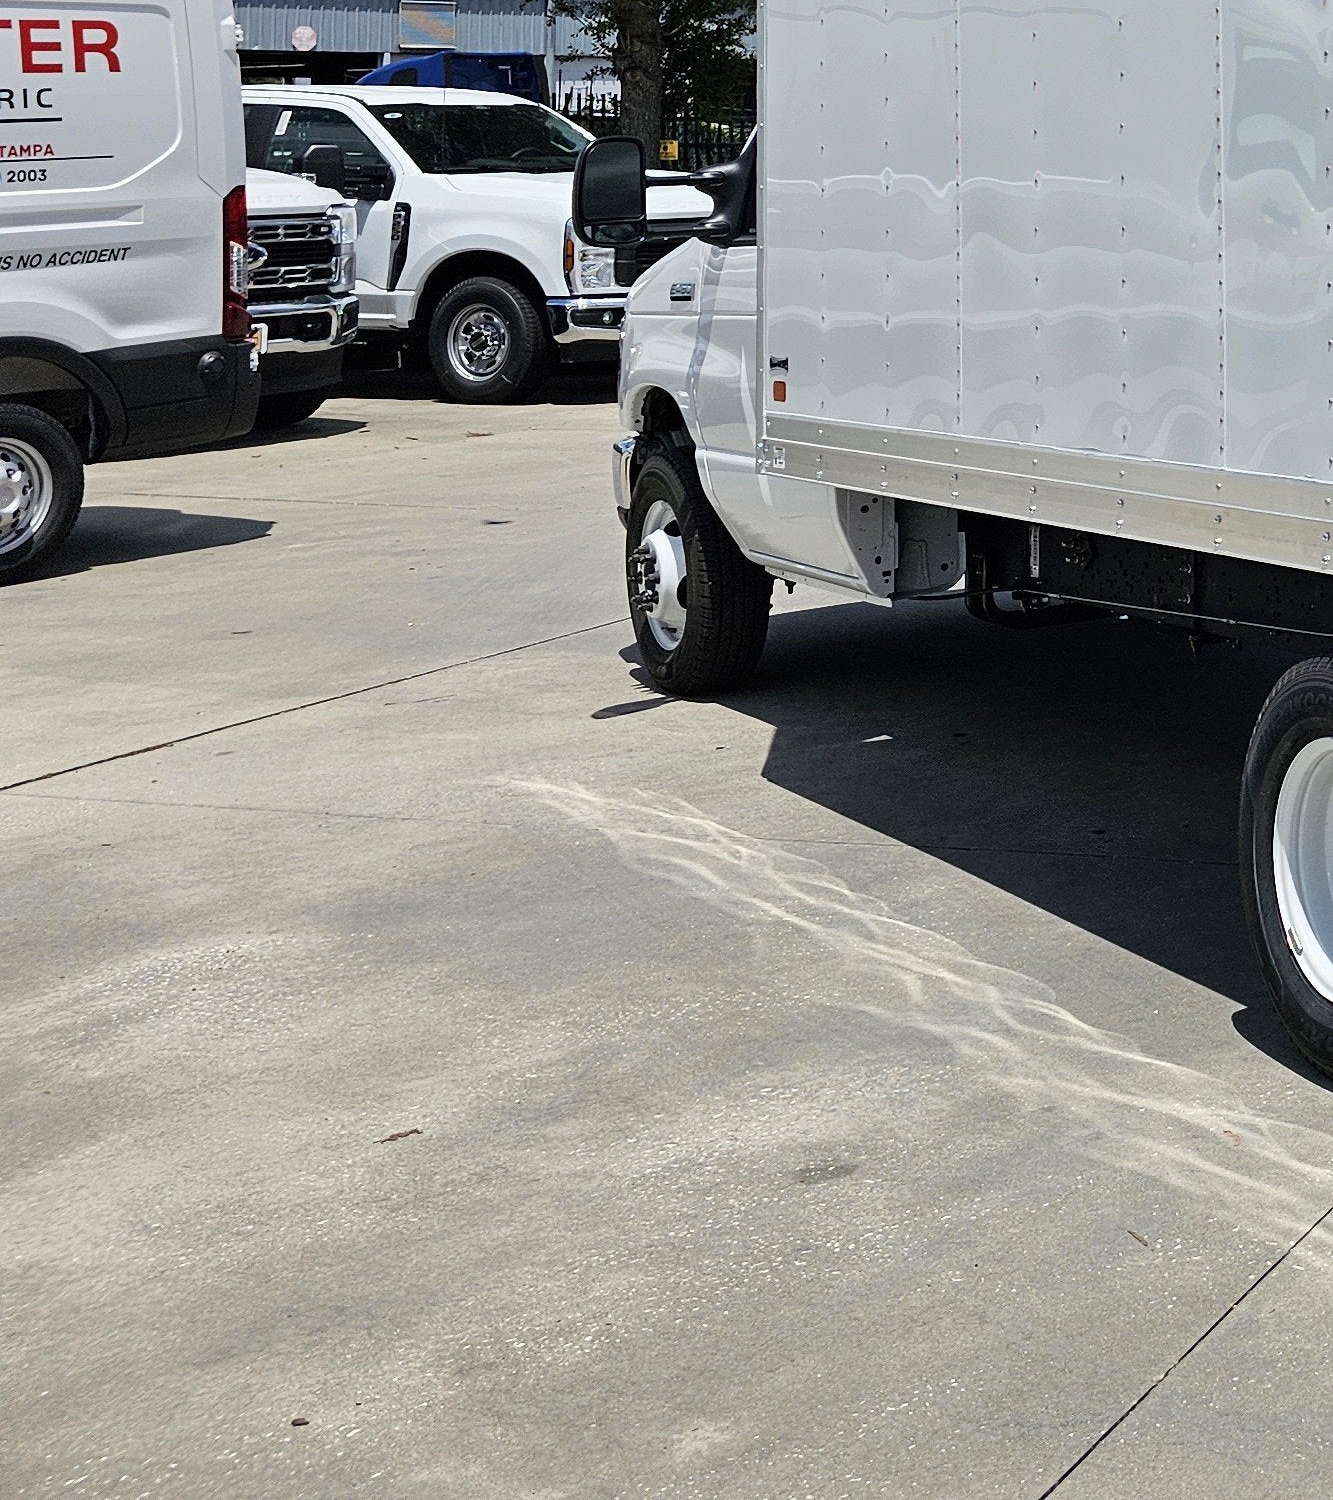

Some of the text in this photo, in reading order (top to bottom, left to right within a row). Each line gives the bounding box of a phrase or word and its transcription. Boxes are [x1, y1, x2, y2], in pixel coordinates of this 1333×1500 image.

[0, 19, 121, 73] ER
[7, 169, 47, 183] 2003
[16, 253, 42, 269] NO
[45, 247, 131, 267] ACCIDENT
